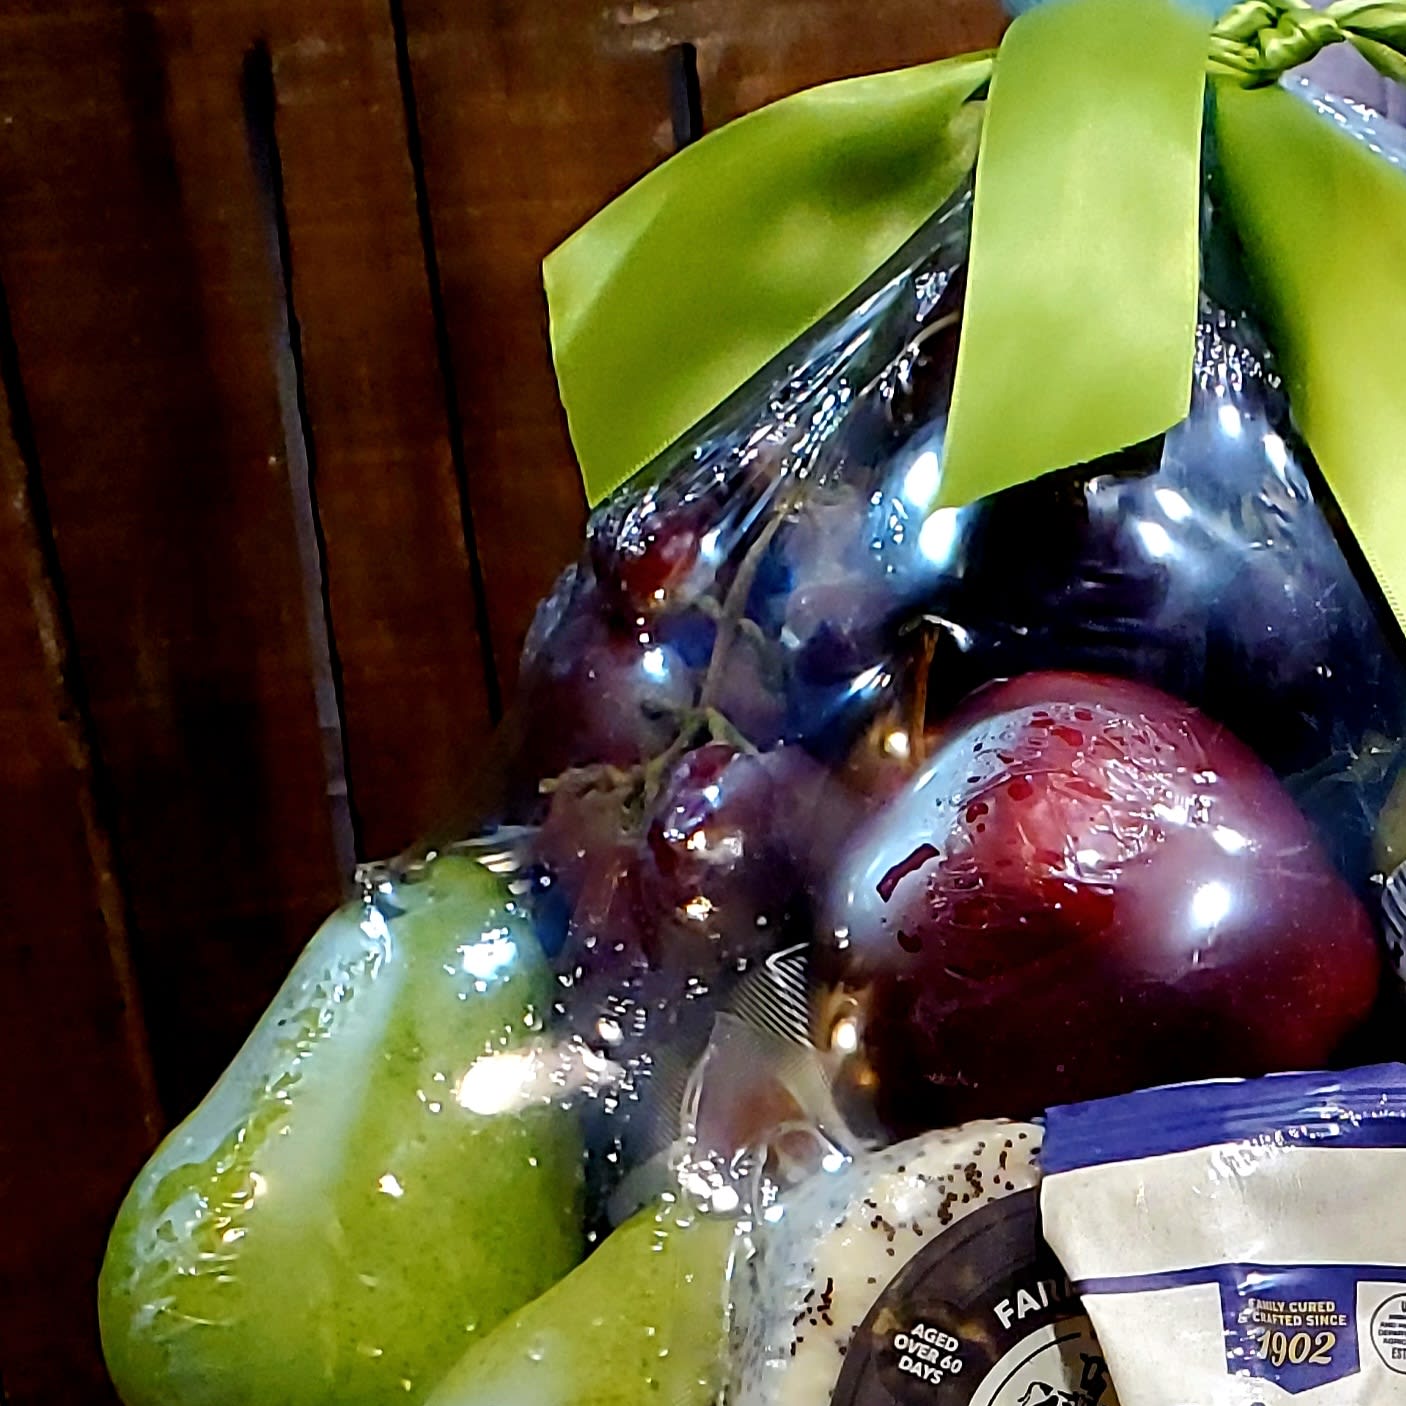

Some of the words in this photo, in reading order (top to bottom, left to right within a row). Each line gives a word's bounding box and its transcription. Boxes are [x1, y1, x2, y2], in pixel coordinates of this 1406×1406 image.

[1253, 1312, 1301, 1326] CRAFTED
[1306, 1314, 1347, 1326] SINCE
[1289, 1301, 1335, 1313] CURED
[911, 1323, 959, 1351] AGED
[1257, 1330, 1336, 1367] 1902
[894, 1334, 940, 1364] OVER
[940, 1355, 963, 1374] 60
[898, 1355, 944, 1385] DAYS
